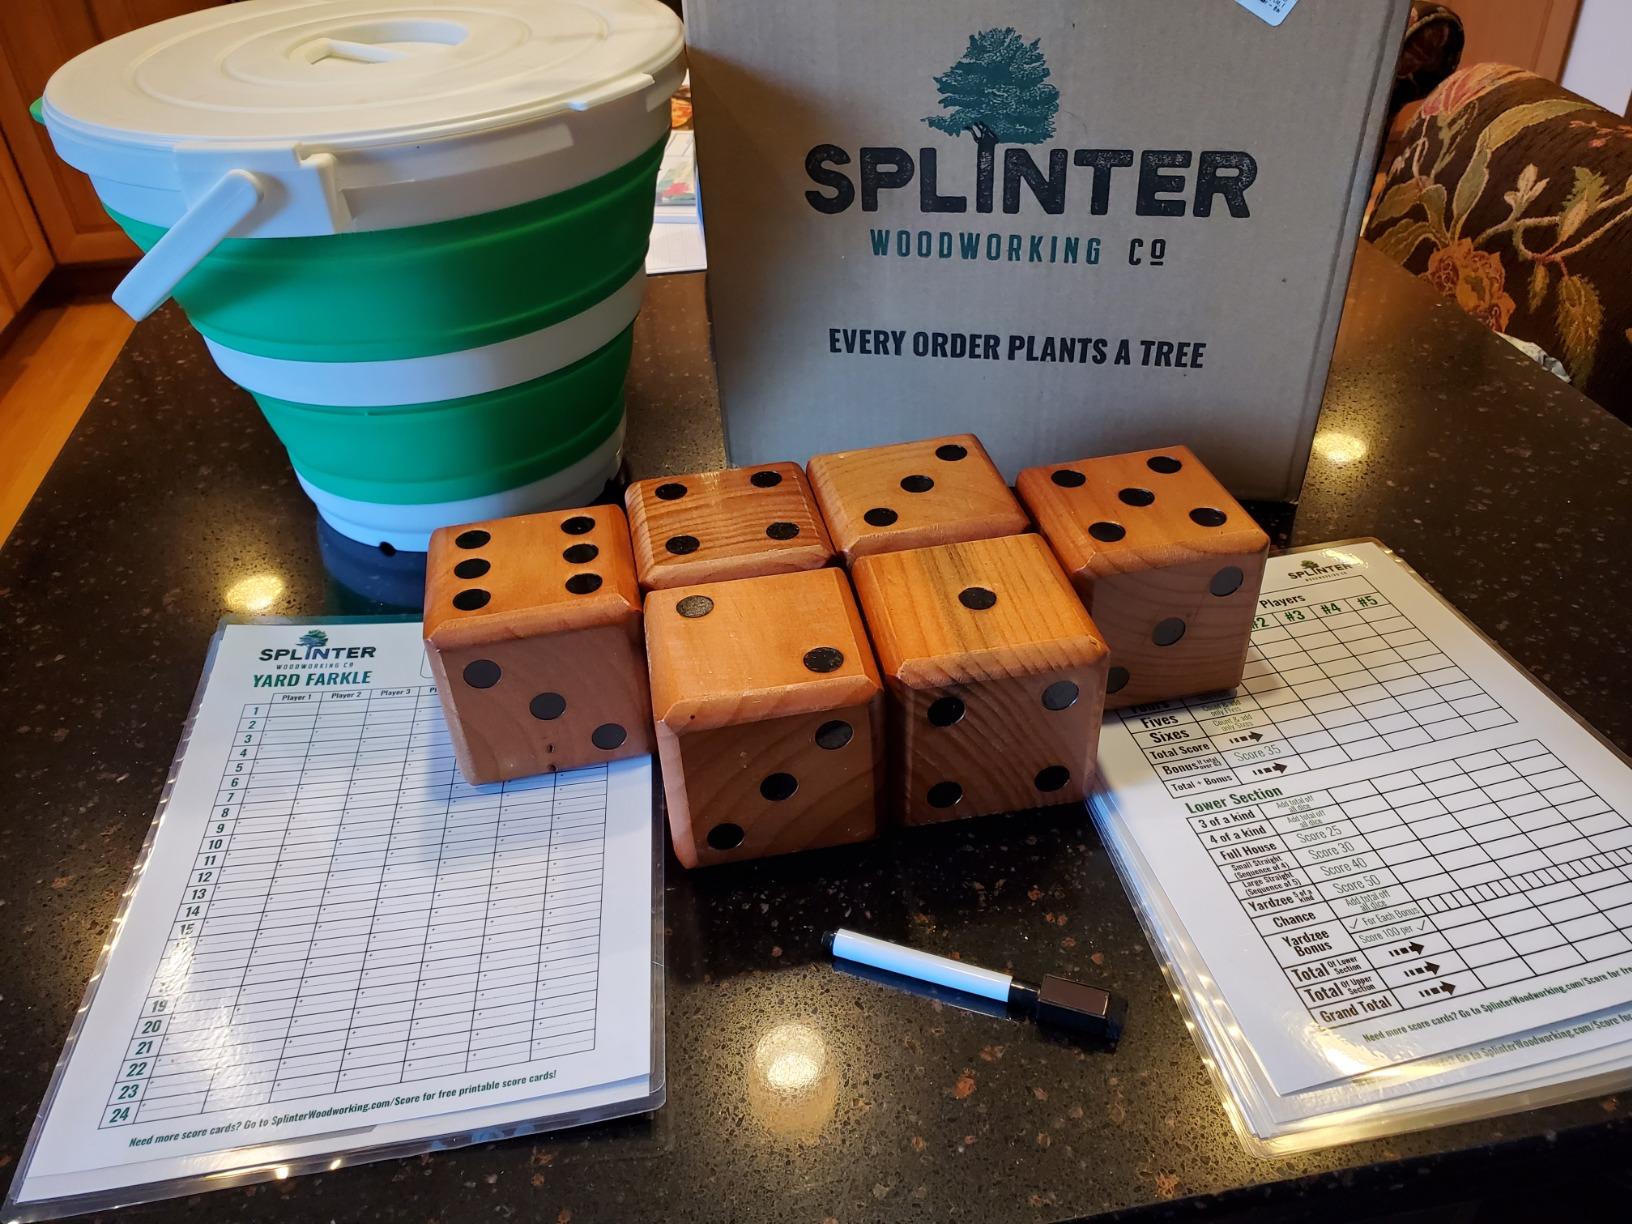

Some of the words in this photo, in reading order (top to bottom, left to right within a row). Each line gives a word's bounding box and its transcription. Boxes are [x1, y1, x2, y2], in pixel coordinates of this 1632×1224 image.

[804, 142, 1258, 218] SPLINTER
[870, 229, 1101, 265] WOODWORKING
[829, 328, 906, 356] EVERY
[913, 331, 1000, 360] ORDER
[1008, 335, 1107, 364] PLANTS
[1114, 339, 1131, 365] A
[1140, 340, 1206, 369] TREE
[1259, 595, 1306, 609] Players
[1284, 610, 1306, 622] #3
[1320, 603, 1341, 615] #4
[1357, 595, 1378, 607] #5
[259, 646, 377, 661] SPLINTER
[253, 673, 301, 688] YARD
[306, 671, 373, 686] FARKLE
[282, 694, 308, 702] Player
[331, 692, 356, 700] Player
[380, 689, 404, 698] Player
[405, 688, 411, 696] 3
[253, 707, 260, 715] 1
[248, 721, 257, 729] 2
[1140, 715, 1179, 729] Fives
[244, 735, 253, 744] 3
[1149, 729, 1190, 743] Sixes
[239, 749, 248, 758] 4
[1150, 748, 1178, 760] Total
[1178, 743, 1210, 755] Score
[1234, 749, 1265, 761] Score
[1264, 744, 1282, 754] 35
[235, 763, 243, 772] 5
[1162, 762, 1199, 775] Bonus
[230, 778, 239, 787] 6
[1171, 781, 1196, 792] Total
[1203, 774, 1233, 786] Bonus
[227, 793, 235, 803] 7
[1185, 798, 1228, 814] Lower
[1229, 786, 1284, 805] Section
[1275, 801, 1289, 809] Add
[1289, 796, 1305, 806] total
[221, 808, 230, 818] 8
[1198, 819, 1208, 829] 3
[1209, 816, 1221, 827] of
[1223, 816, 1231, 824] a
[1230, 809, 1256, 822] kind
[1286, 815, 1300, 824] Add
[1300, 812, 1316, 821] total
[216, 823, 225, 833] 9
[1210, 834, 1218, 844] 4
[1219, 832, 1231, 843] of
[1233, 831, 1241, 840] a
[1241, 825, 1267, 838] kind
[1296, 832, 1327, 844] Score
[1325, 825, 1343, 837] 25
[208, 839, 223, 850] 10
[1220, 848, 1243, 861] Full
[1241, 842, 1277, 856] House
[1308, 846, 1339, 860] Score
[1338, 841, 1355, 853] 30
[204, 855, 217, 866] 11
[1231, 861, 1253, 872] Small
[1252, 855, 1283, 867] Straight
[1319, 863, 1351, 876] Score
[1351, 857, 1368, 870] 40
[198, 871, 213, 883] 12
[1234, 866, 1272, 880] (Sequence
[1272, 863, 1281, 872] of
[1280, 861, 1290, 870] 4)
[1242, 878, 1264, 888] Large
[1263, 871, 1294, 883] Straight
[1245, 884, 1284, 897] (Sequence
[1292, 877, 1302, 886] 5)
[1332, 880, 1365, 894] Score
[1363, 874, 1381, 887] 50
[191, 888, 207, 900] 13
[1298, 895, 1315, 903] kind
[1299, 889, 1307, 897] of
[1344, 897, 1360, 907] Add
[1360, 892, 1379, 903] total
[185, 905, 201, 917] 14
[1248, 895, 1295, 912] Yardzee
[1360, 904, 1371, 912] all
[1371, 899, 1388, 911] dice
[1272, 912, 1317, 928] Chance
[1361, 916, 1376, 927] For
[1375, 911, 1394, 923] Each
[1393, 906, 1420, 919] Bonus
[1281, 930, 1330, 947] Yardzee
[1358, 931, 1384, 944] Score
[1382, 926, 1401, 938] 100
[1400, 925, 1414, 936] per
[1294, 941, 1333, 957] Bonus
[1327, 960, 1337, 968] Of
[1336, 956, 1358, 966] Lower
[1334, 963, 1362, 975] Section
[1291, 962, 1331, 982] Total
[1340, 980, 1349, 988] Of
[1349, 975, 1373, 987] Upper
[1347, 983, 1376, 995] Section
[1303, 982, 1344, 1003] Total
[152, 1000, 168, 1013] 19
[1319, 1003, 1360, 1023] Grand
[1357, 995, 1393, 1013] Total
[1362, 1030, 1385, 1043] Need
[1385, 1026, 1408, 1037] more
[1407, 1019, 1431, 1031] score
[1431, 1012, 1458, 1026] cards?
[1458, 1008, 1472, 1018] Go
[1471, 1007, 1481, 1015] to
[1481, 974, 1608, 1013] SplinterWoodworking.com/Score
[1607, 970, 1622, 979] for
[142, 1020, 162, 1034] 20
[1481, 1015, 1621, 1058] SplinterWoodworking.com/Score
[134, 1040, 153, 1056] 21
[126, 1061, 148, 1077] 22
[117, 1084, 140, 1100] 23
[109, 1106, 131, 1124] 24
[129, 1135, 153, 1147] Need
[154, 1133, 180, 1143] more
[181, 1129, 207, 1140] score
[209, 1121, 243, 1136] cards?
[243, 1120, 257, 1131] Go
[258, 1118, 269, 1128] to
[271, 1095, 420, 1127] SplinterWoodworking.com/Score
[422, 1091, 437, 1102] for
[438, 1088, 457, 1100] free
[458, 1077, 501, 1098] printable
[502, 1077, 527, 1089] score
[528, 1069, 557, 1084] cards!
